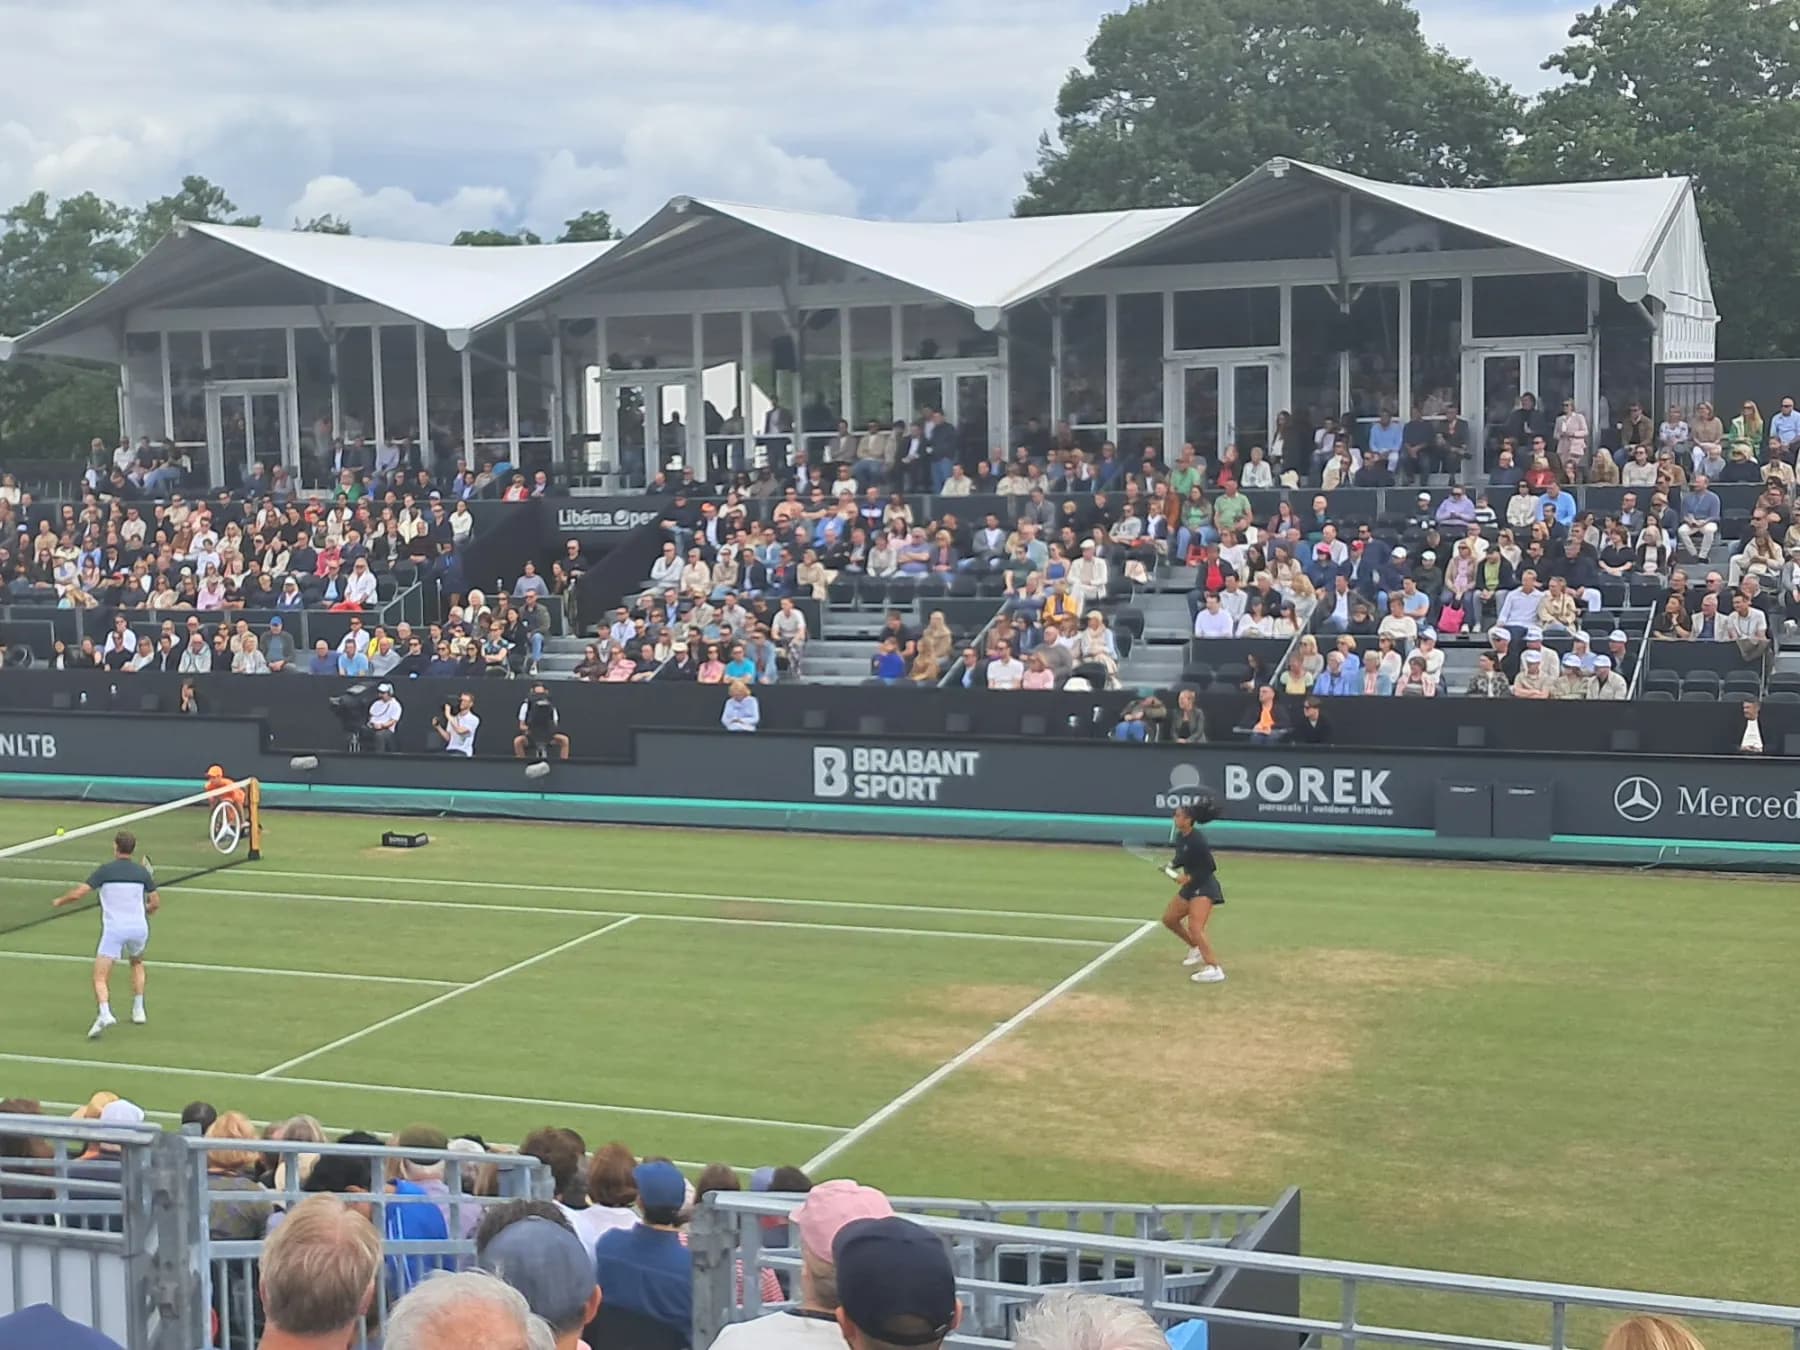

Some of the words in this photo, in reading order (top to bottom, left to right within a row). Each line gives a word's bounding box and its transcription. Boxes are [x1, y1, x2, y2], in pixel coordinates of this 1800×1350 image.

[558, 508, 612, 525] Libéma
[0, 733, 57, 758] NLTB
[853, 747, 980, 776] BRABANT
[854, 774, 942, 801] SPORT
[1225, 764, 1392, 806] BOREK
